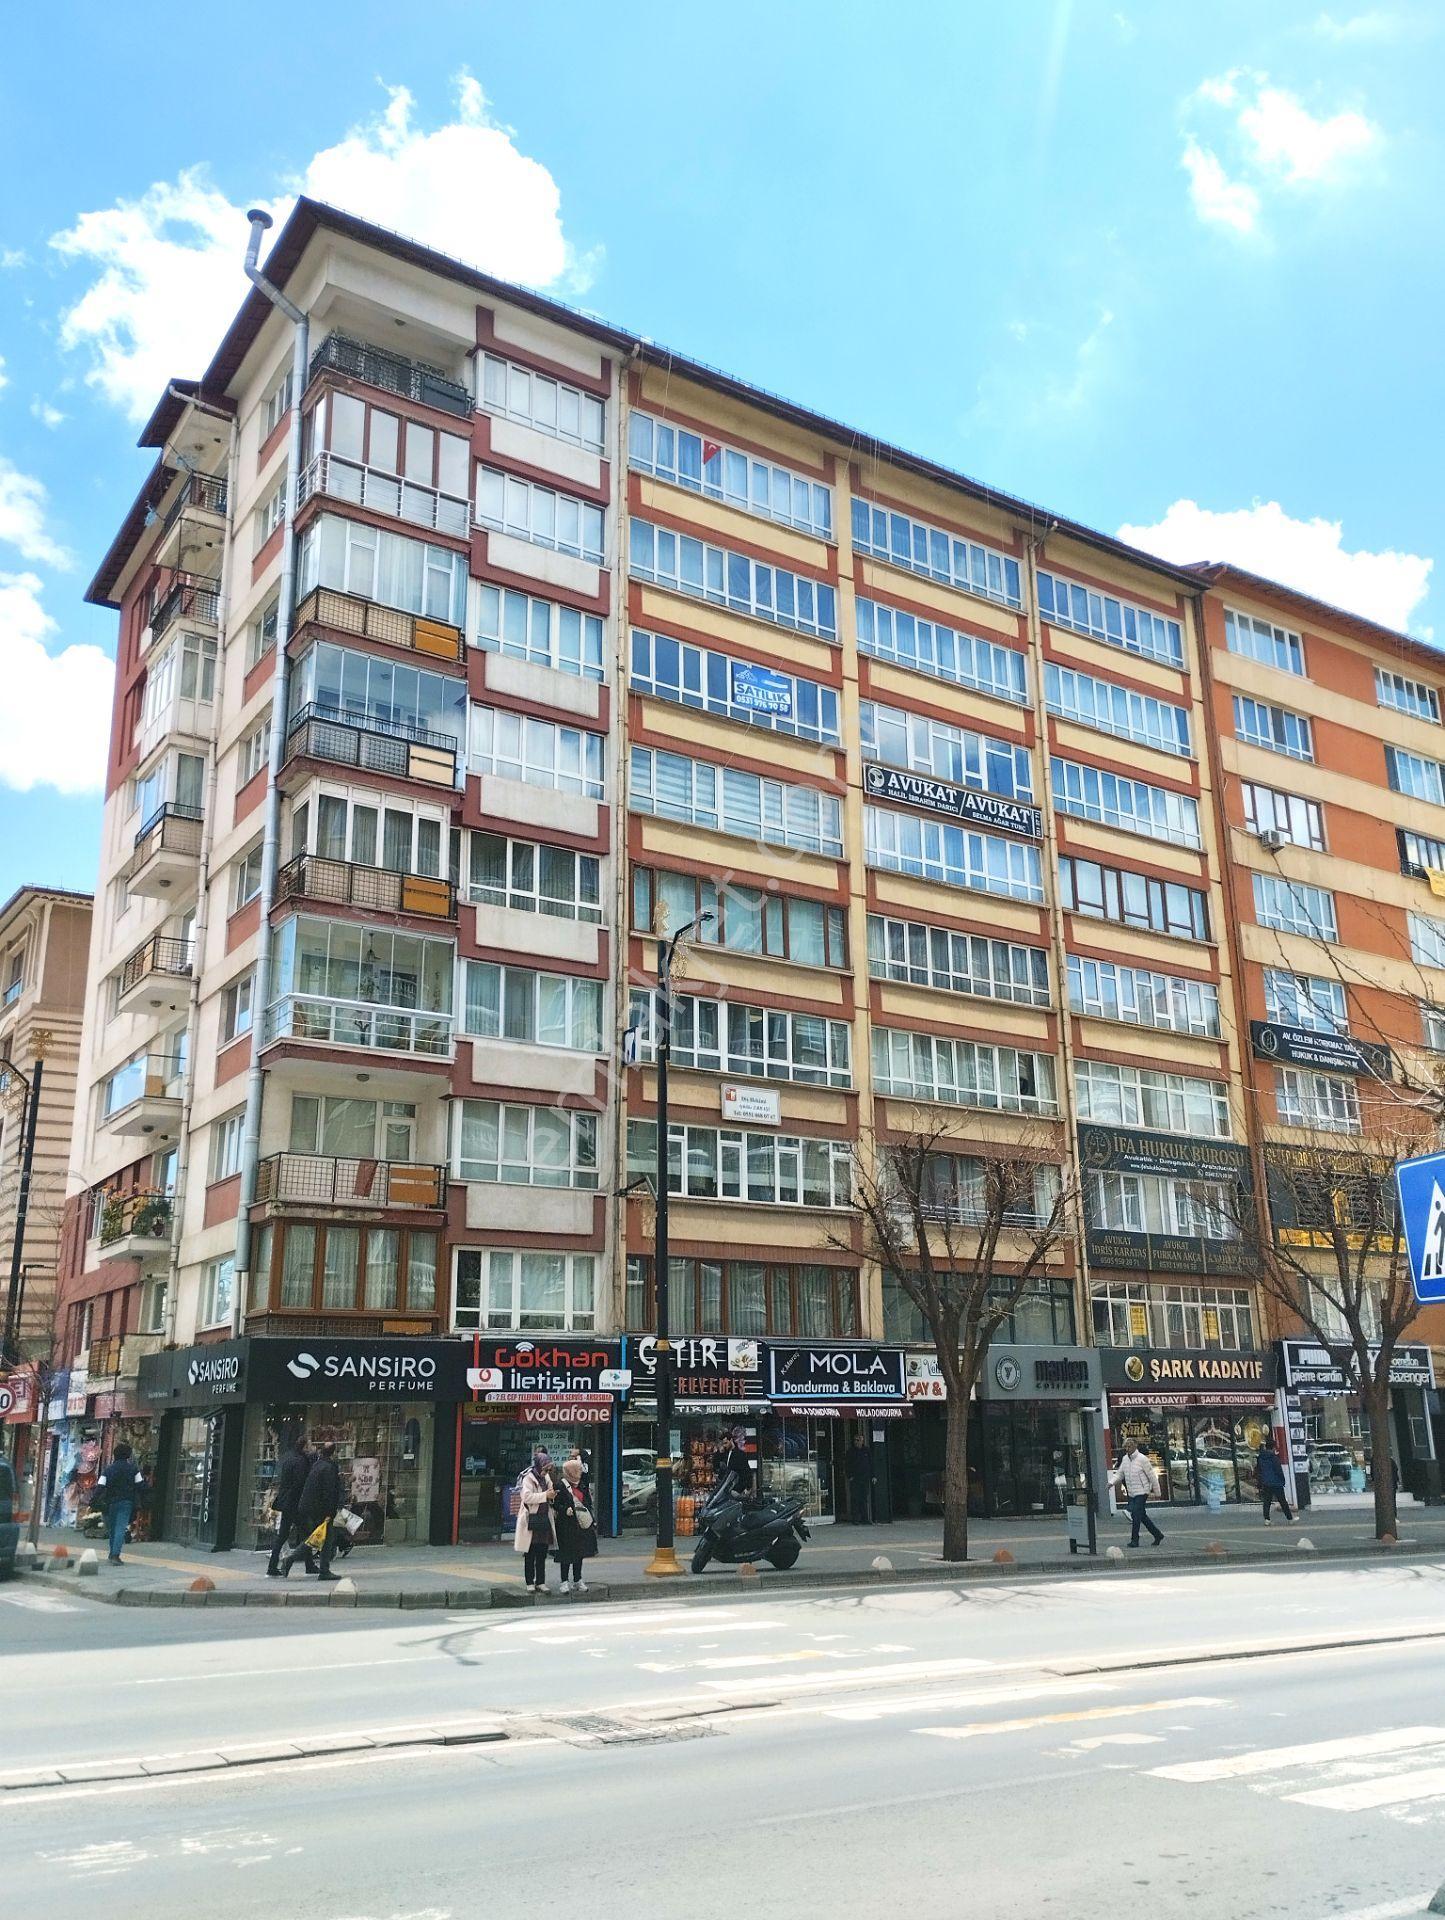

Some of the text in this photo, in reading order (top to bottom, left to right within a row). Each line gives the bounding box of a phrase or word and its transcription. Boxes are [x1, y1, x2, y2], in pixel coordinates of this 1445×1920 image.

[736, 684, 788, 703] SATILIK
[888, 773, 958, 804] AVUKAT
[966, 794, 1031, 824] AVUKAT
[1291, 1050, 1312, 1061] HUKUK
[1113, 1133, 1136, 1154] İFA
[1138, 1138, 1191, 1162] HUKUK
[1191, 1144, 1244, 1168] BÜROSU
[1104, 1236, 1131, 1245] AVUKAT
[1163, 1240, 1189, 1250] AVUKAT
[640, 1336, 718, 1374] ÇTIR
[810, 1353, 888, 1376] MOLA
[1150, 1358, 1263, 1382] ŞARK KADAYIF
[369, 1381, 434, 1391] PERFUME
[510, 1368, 591, 1393] İletişim
[1291, 1369, 1316, 1386] pierre
[1316, 1369, 1343, 1382] cardin
[212, 1382, 237, 1395] PERFUME
[678, 1373, 746, 1400] RUYEMİŞ
[783, 1380, 896, 1396] Dondurma & Baklava
[908, 1382, 942, 1398] ÇAY &
[1118, 1396, 1188, 1406] ŞARK KADAYIF
[1200, 1396, 1266, 1405] ŞARK DONDURMA
[524, 1404, 610, 1422] vodafone
